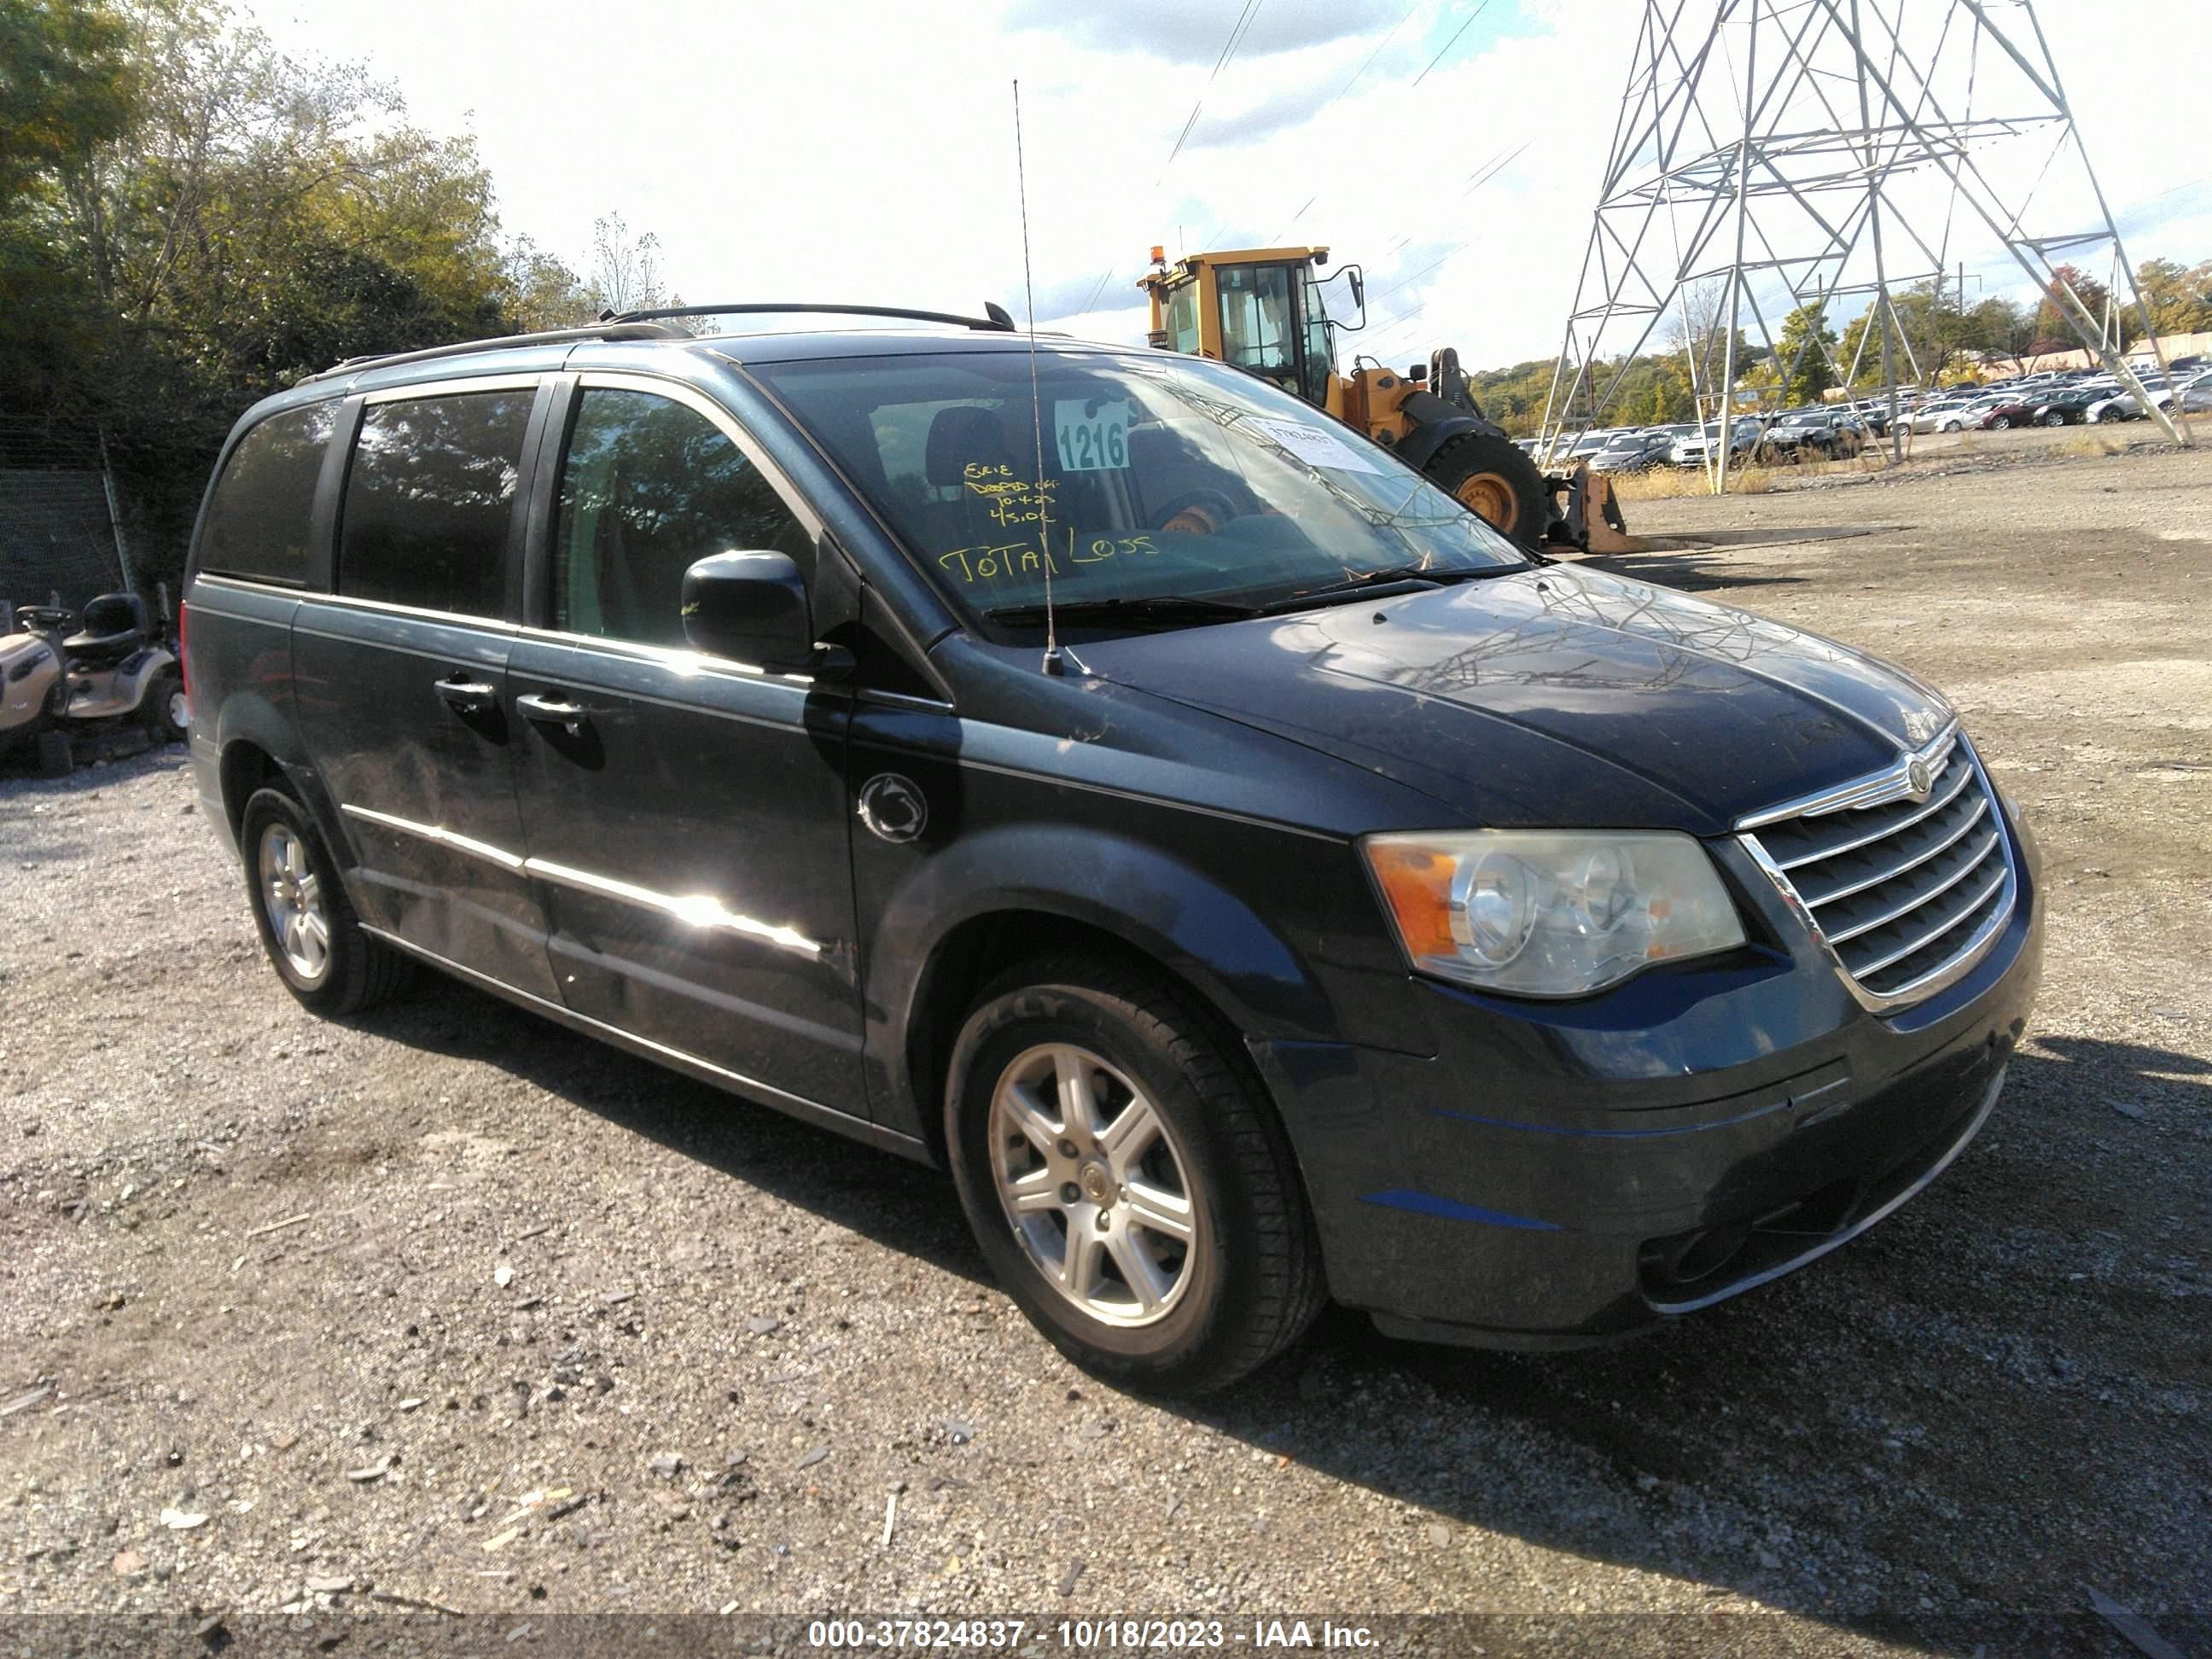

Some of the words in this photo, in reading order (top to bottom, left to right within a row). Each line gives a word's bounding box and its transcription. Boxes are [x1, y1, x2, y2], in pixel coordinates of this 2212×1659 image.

[1060, 422, 1124, 469] 1216
[963, 463, 1013, 478] ERIE
[1069, 527, 1160, 563] LOSS
